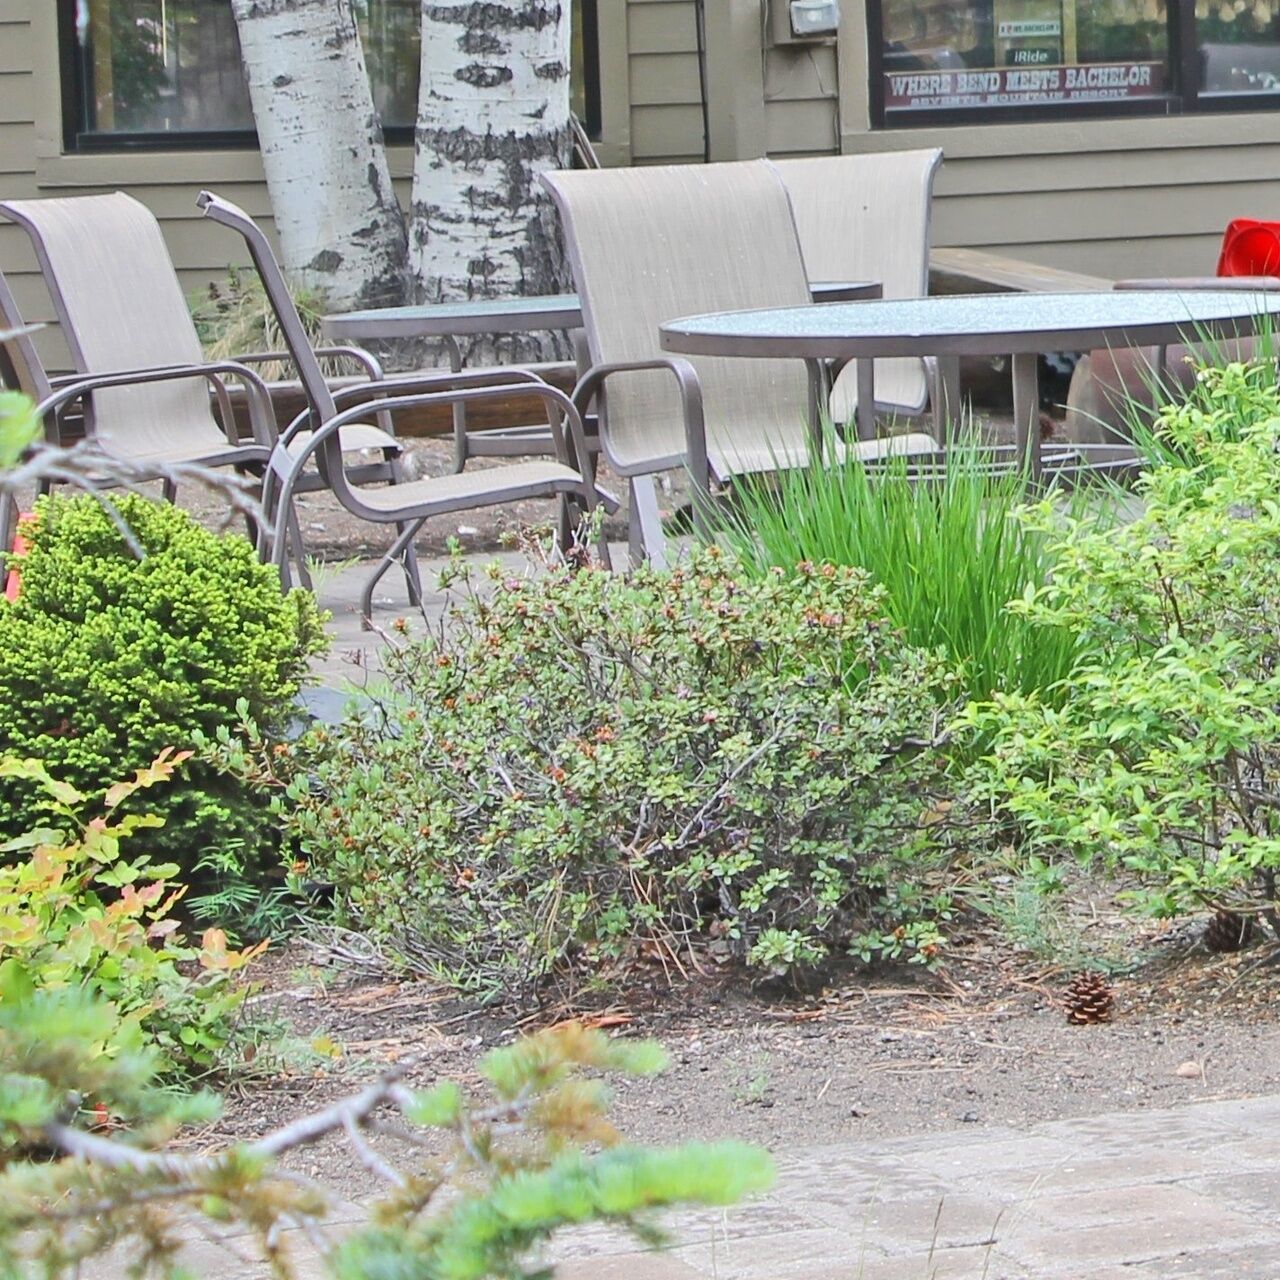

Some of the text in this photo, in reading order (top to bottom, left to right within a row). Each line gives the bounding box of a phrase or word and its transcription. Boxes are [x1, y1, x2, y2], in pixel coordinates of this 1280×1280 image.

[1014, 50, 1049, 62] iRide
[891, 66, 1151, 96] WHERE BEND MEETS BACHELOR
